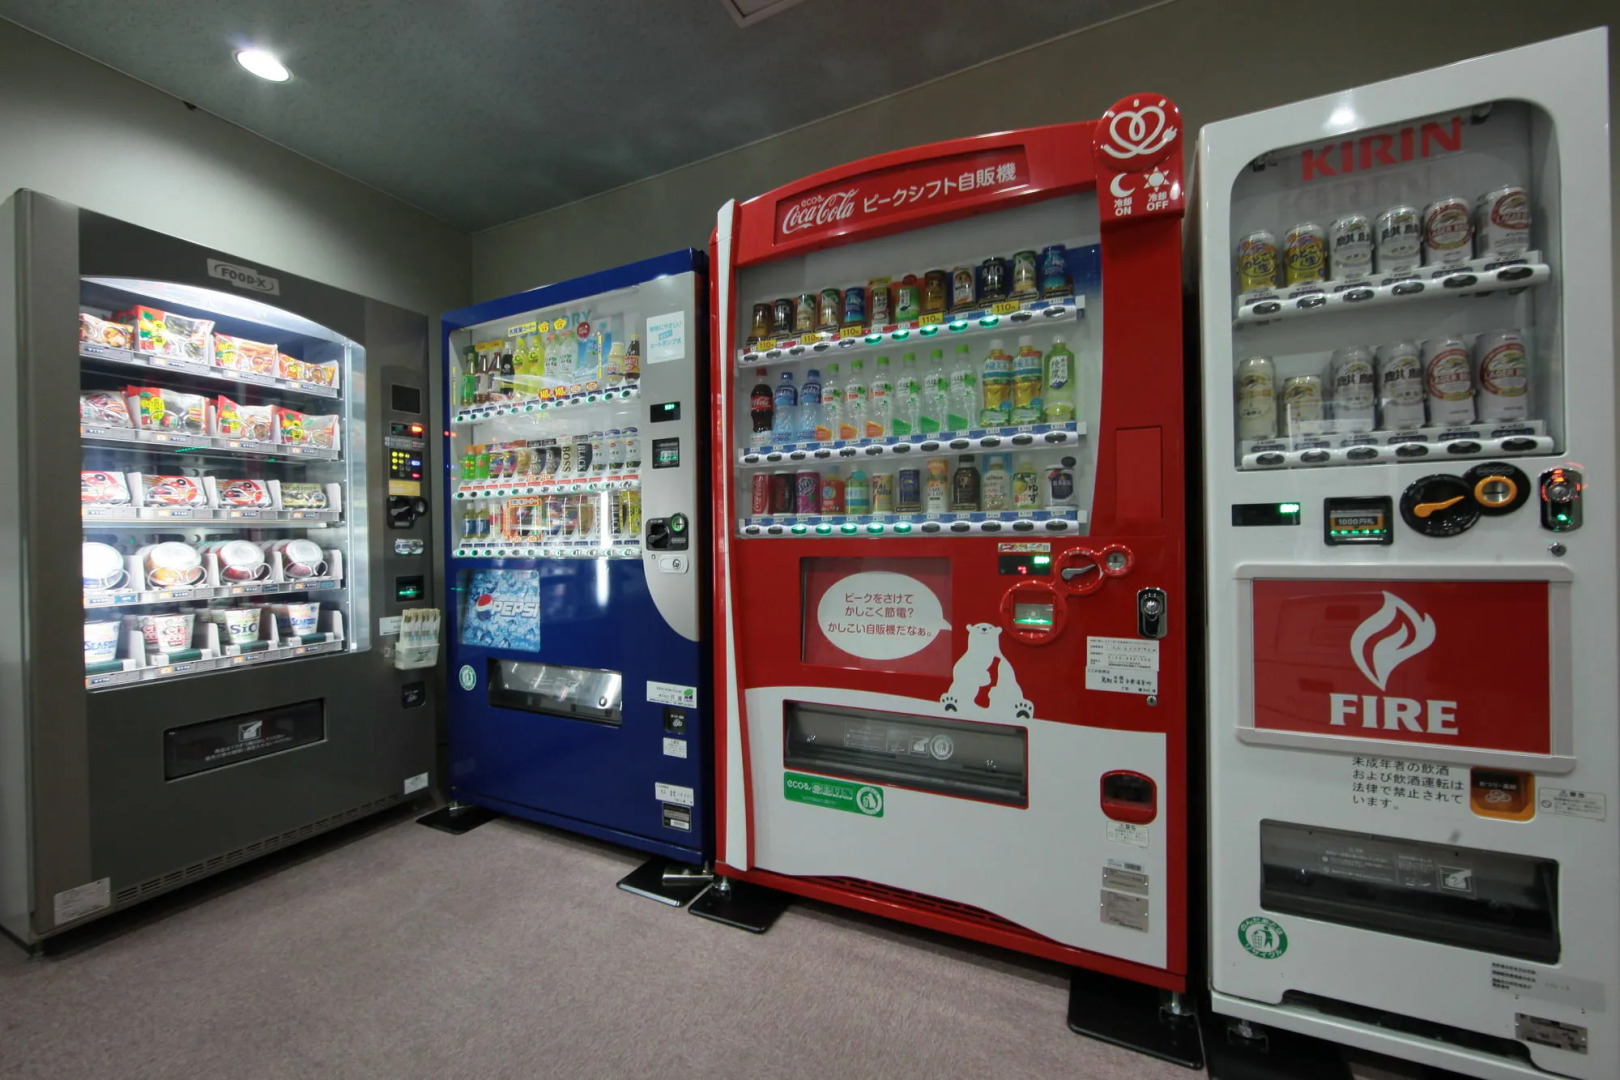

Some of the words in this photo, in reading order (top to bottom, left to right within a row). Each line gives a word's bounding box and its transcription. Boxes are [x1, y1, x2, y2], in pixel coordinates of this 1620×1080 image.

[1301, 116, 1462, 182] KIRIN
[864, 162, 1016, 213] ピークシフト自販機
[1148, 191, 1167, 202] 冷却
[782, 188, 859, 234] Coca-Cola
[1114, 197, 1132, 208] 冷却
[1115, 206, 1132, 216] ON
[1146, 201, 1169, 211] OFF
[221, 267, 267, 289] FOOD-X
[562, 446, 571, 473] BOSS
[845, 592, 914, 605] ピークをさけて
[492, 600, 539, 619] PEPSI
[828, 622, 932, 637] かしこい自販機だなぁ。
[1329, 693, 1459, 735] FIRE
[1352, 757, 1449, 776] 未成年者の飲酒
[1352, 769, 1464, 791] および飲酒運転は
[1352, 783, 1463, 804] 法律で禁止されて
